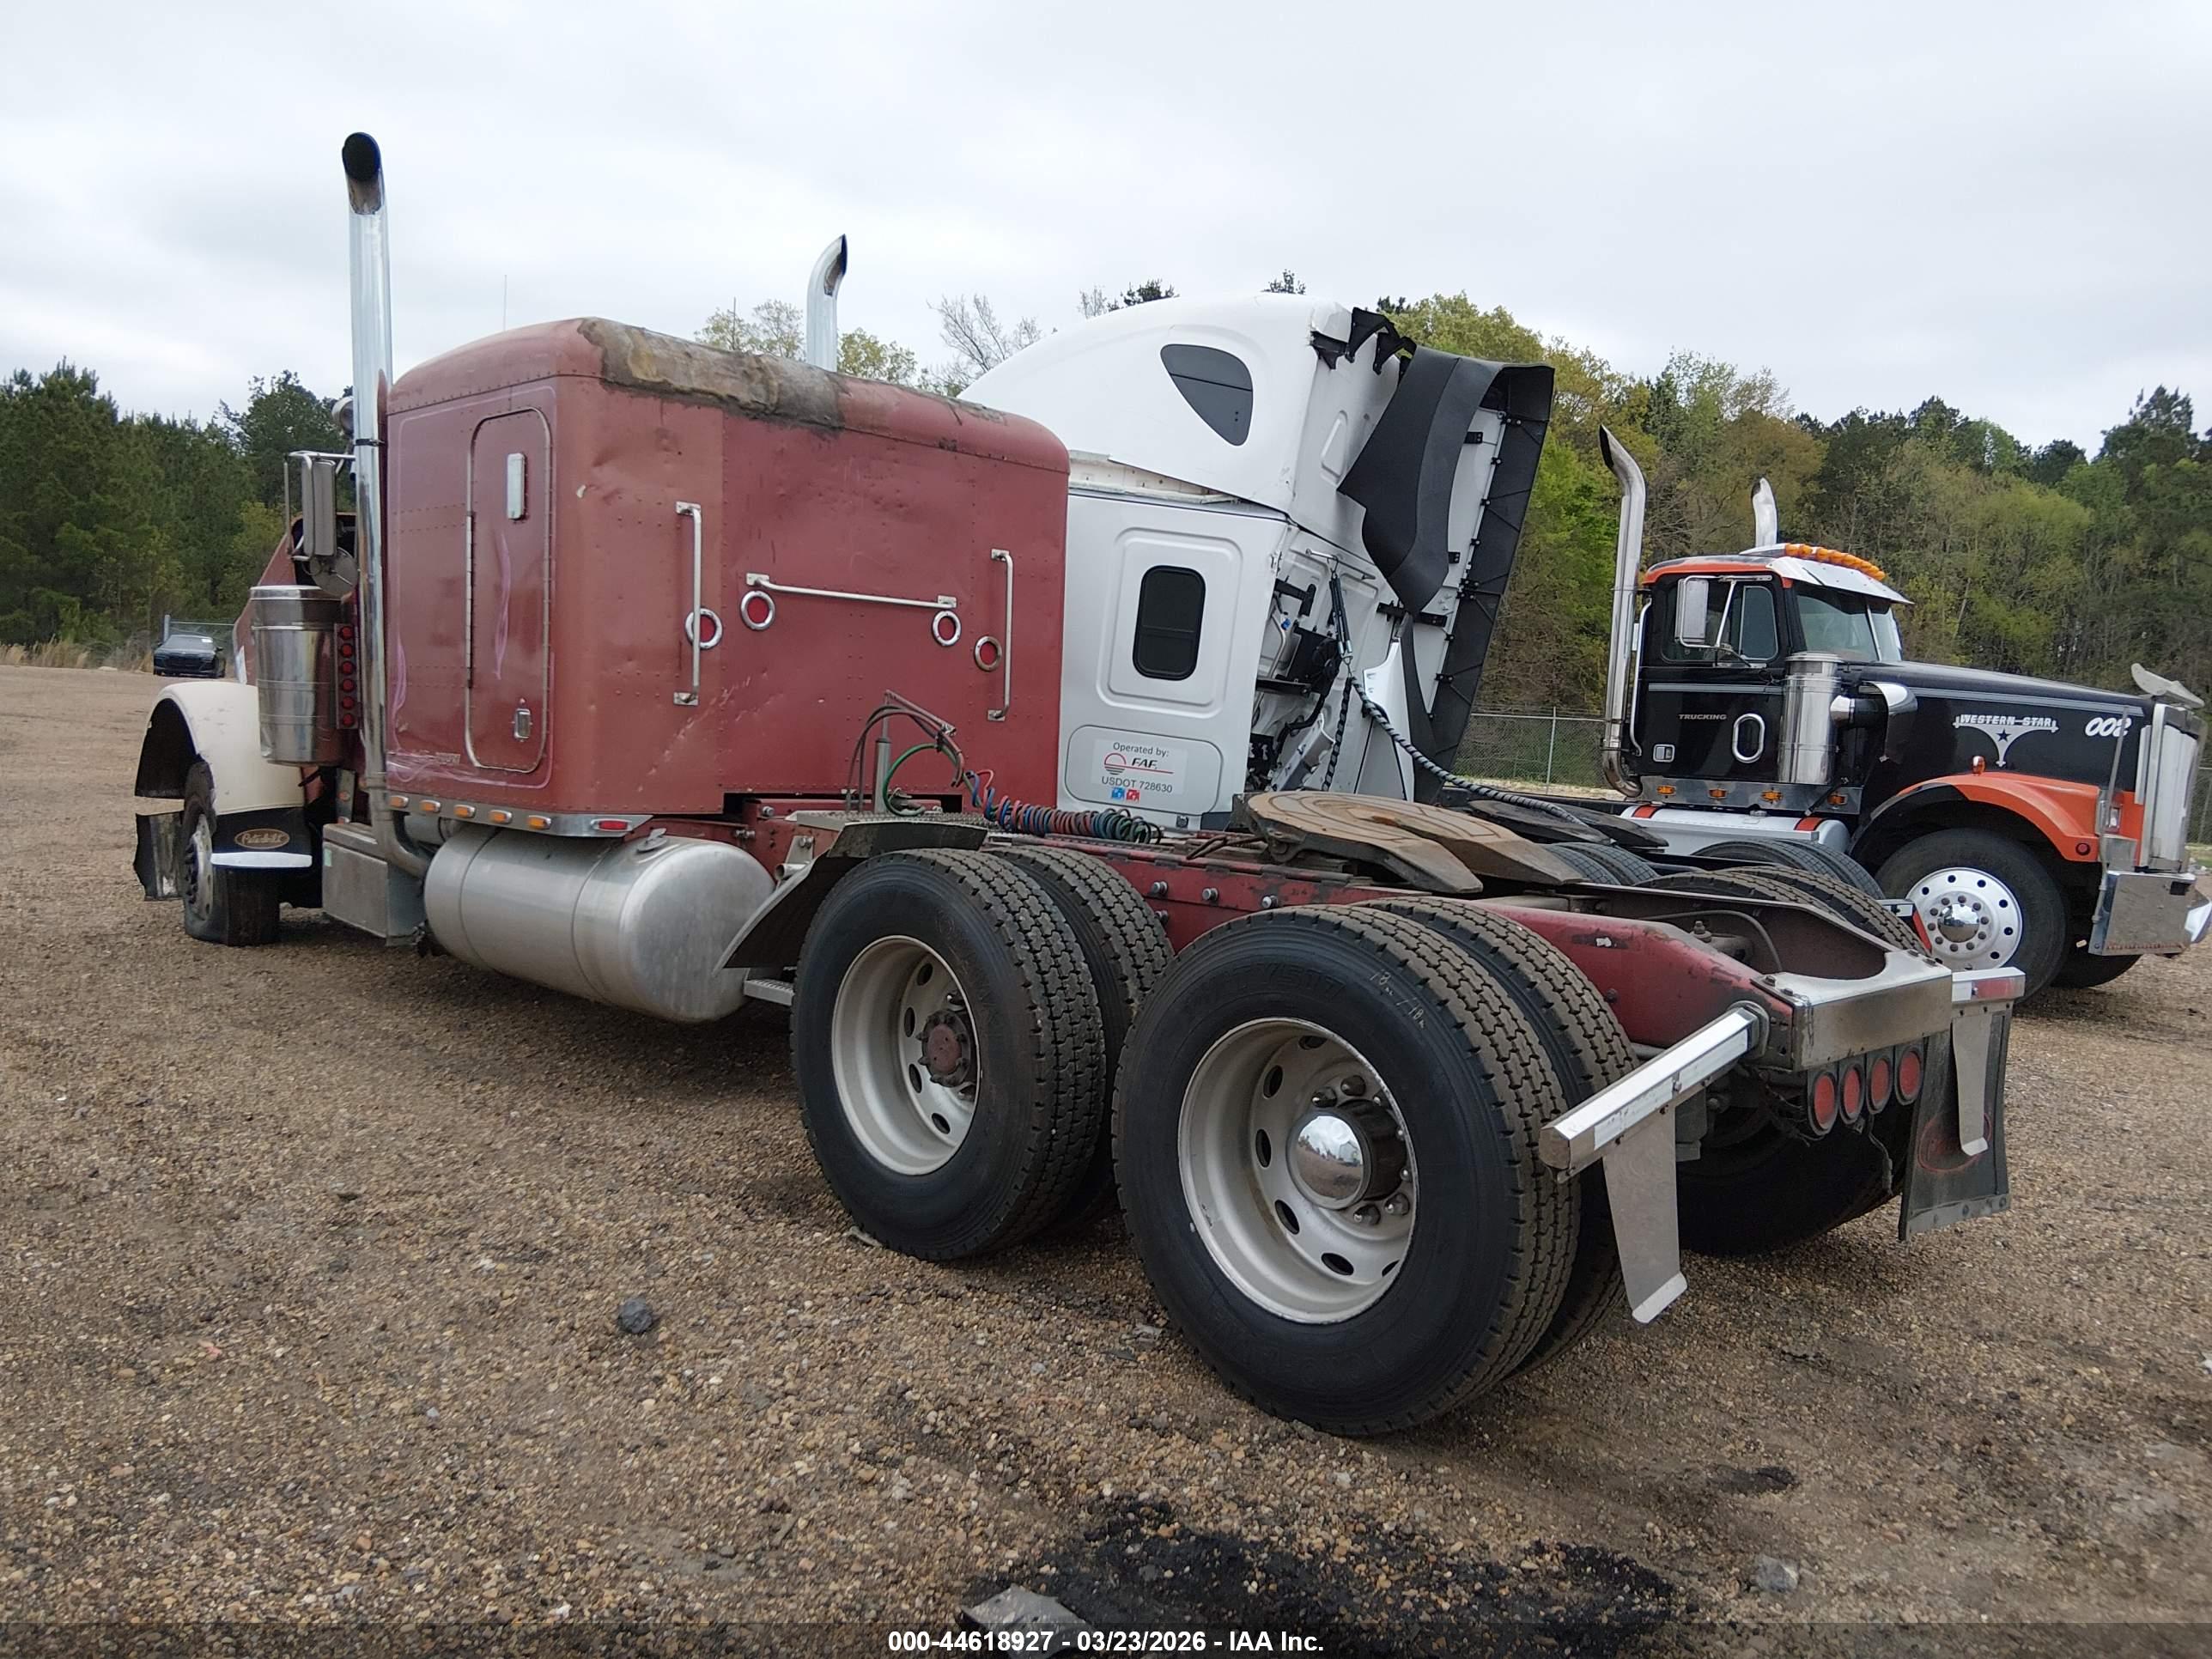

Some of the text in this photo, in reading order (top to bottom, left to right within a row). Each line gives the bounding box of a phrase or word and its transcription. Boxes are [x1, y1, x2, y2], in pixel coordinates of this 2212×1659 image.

[2084, 716, 2132, 738] 002
[1113, 741, 1170, 758] Operated by:
[1101, 775, 1173, 793] USDOT 728630
